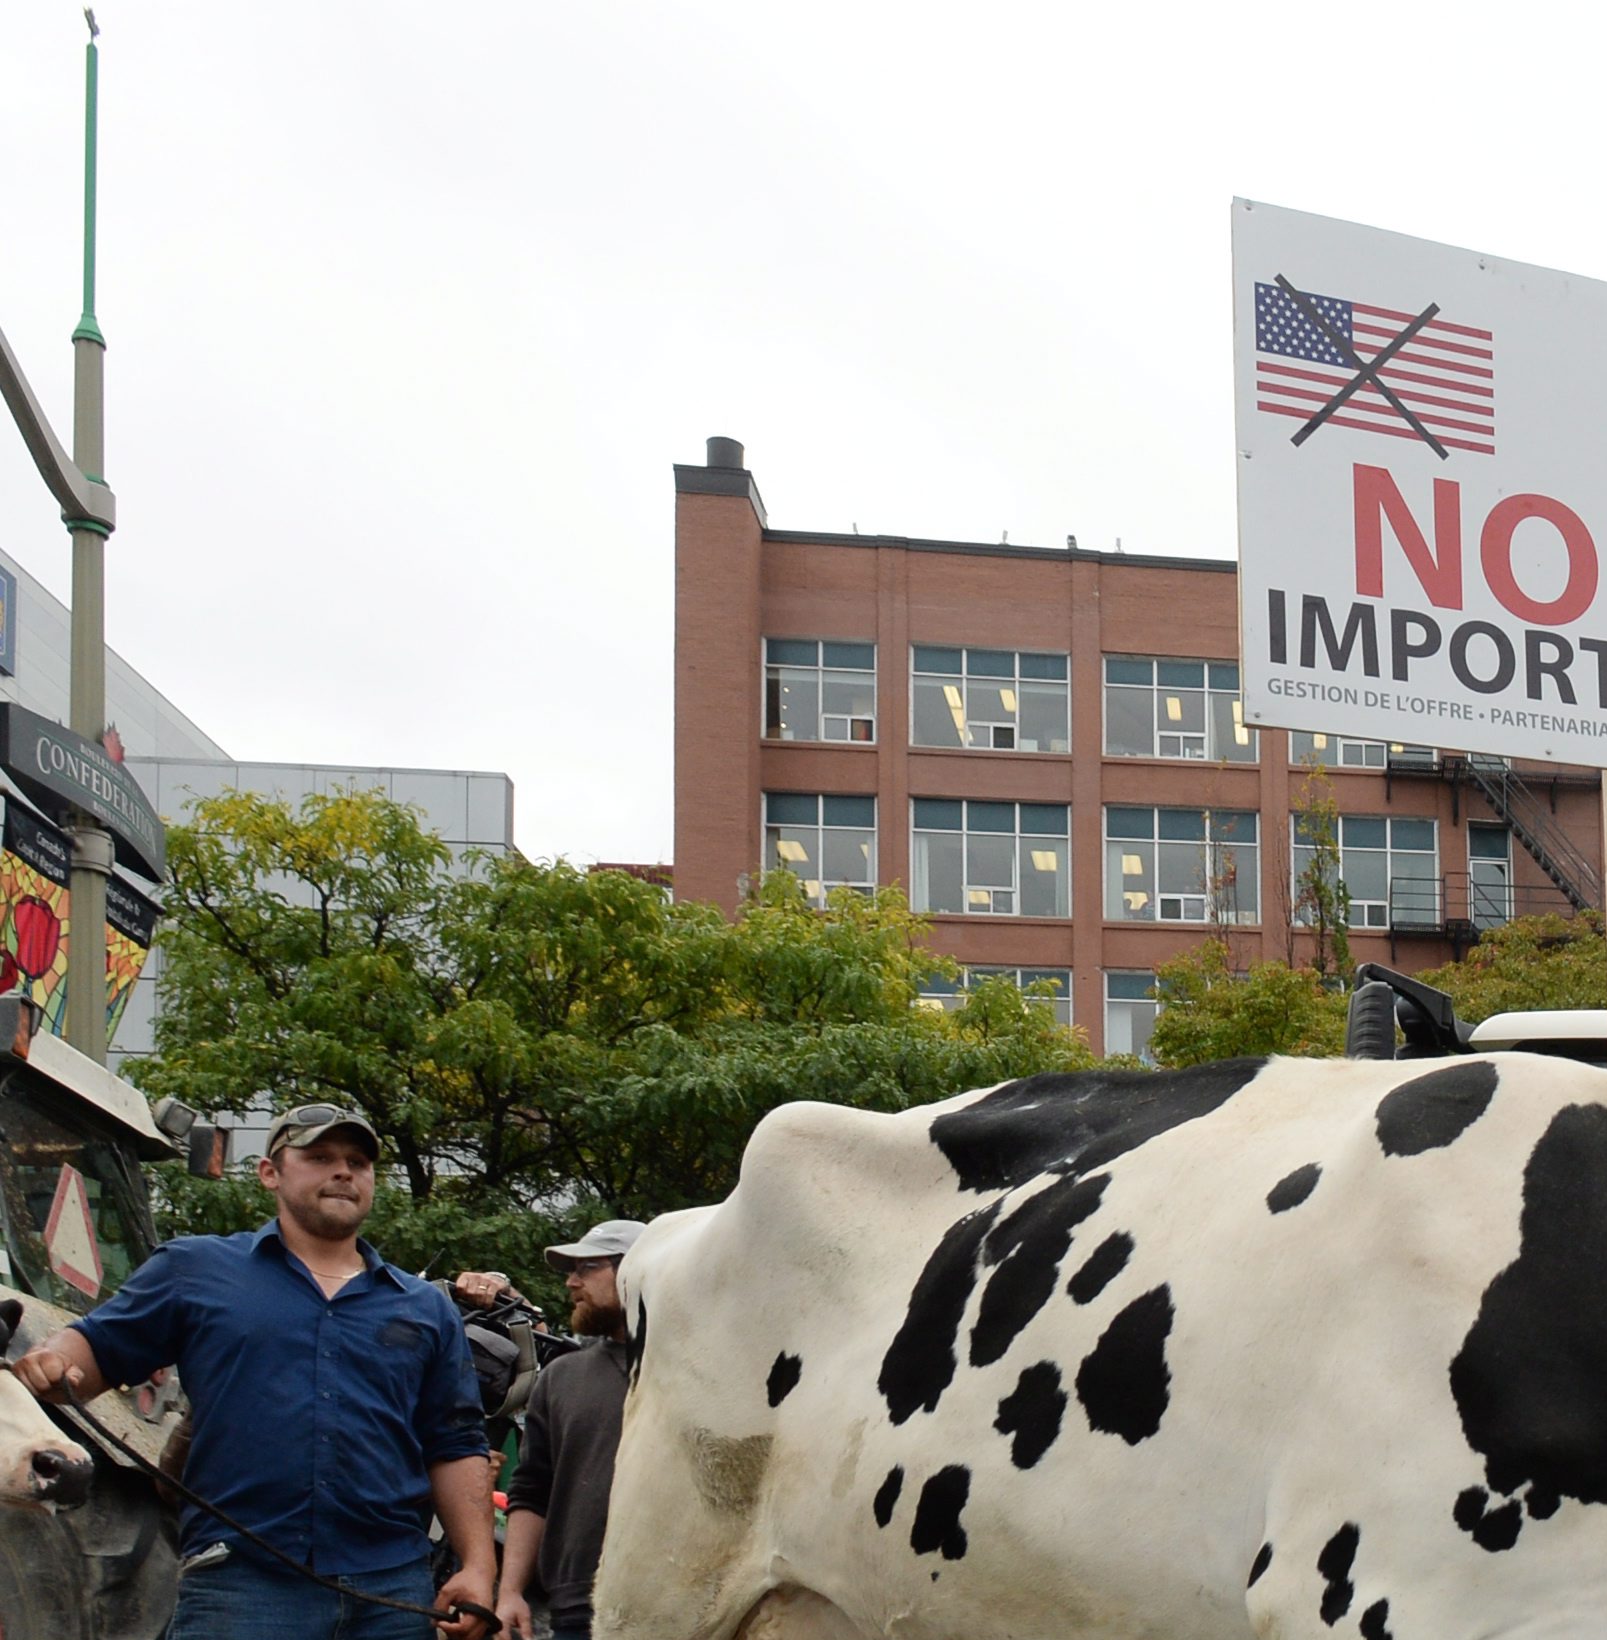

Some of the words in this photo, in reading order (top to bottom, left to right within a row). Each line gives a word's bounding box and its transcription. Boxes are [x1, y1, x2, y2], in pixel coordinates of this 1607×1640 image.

[1267, 677, 1358, 706] GESTION
[1364, 690, 1391, 709] DE
[1397, 695, 1474, 721] L'OFFRE
